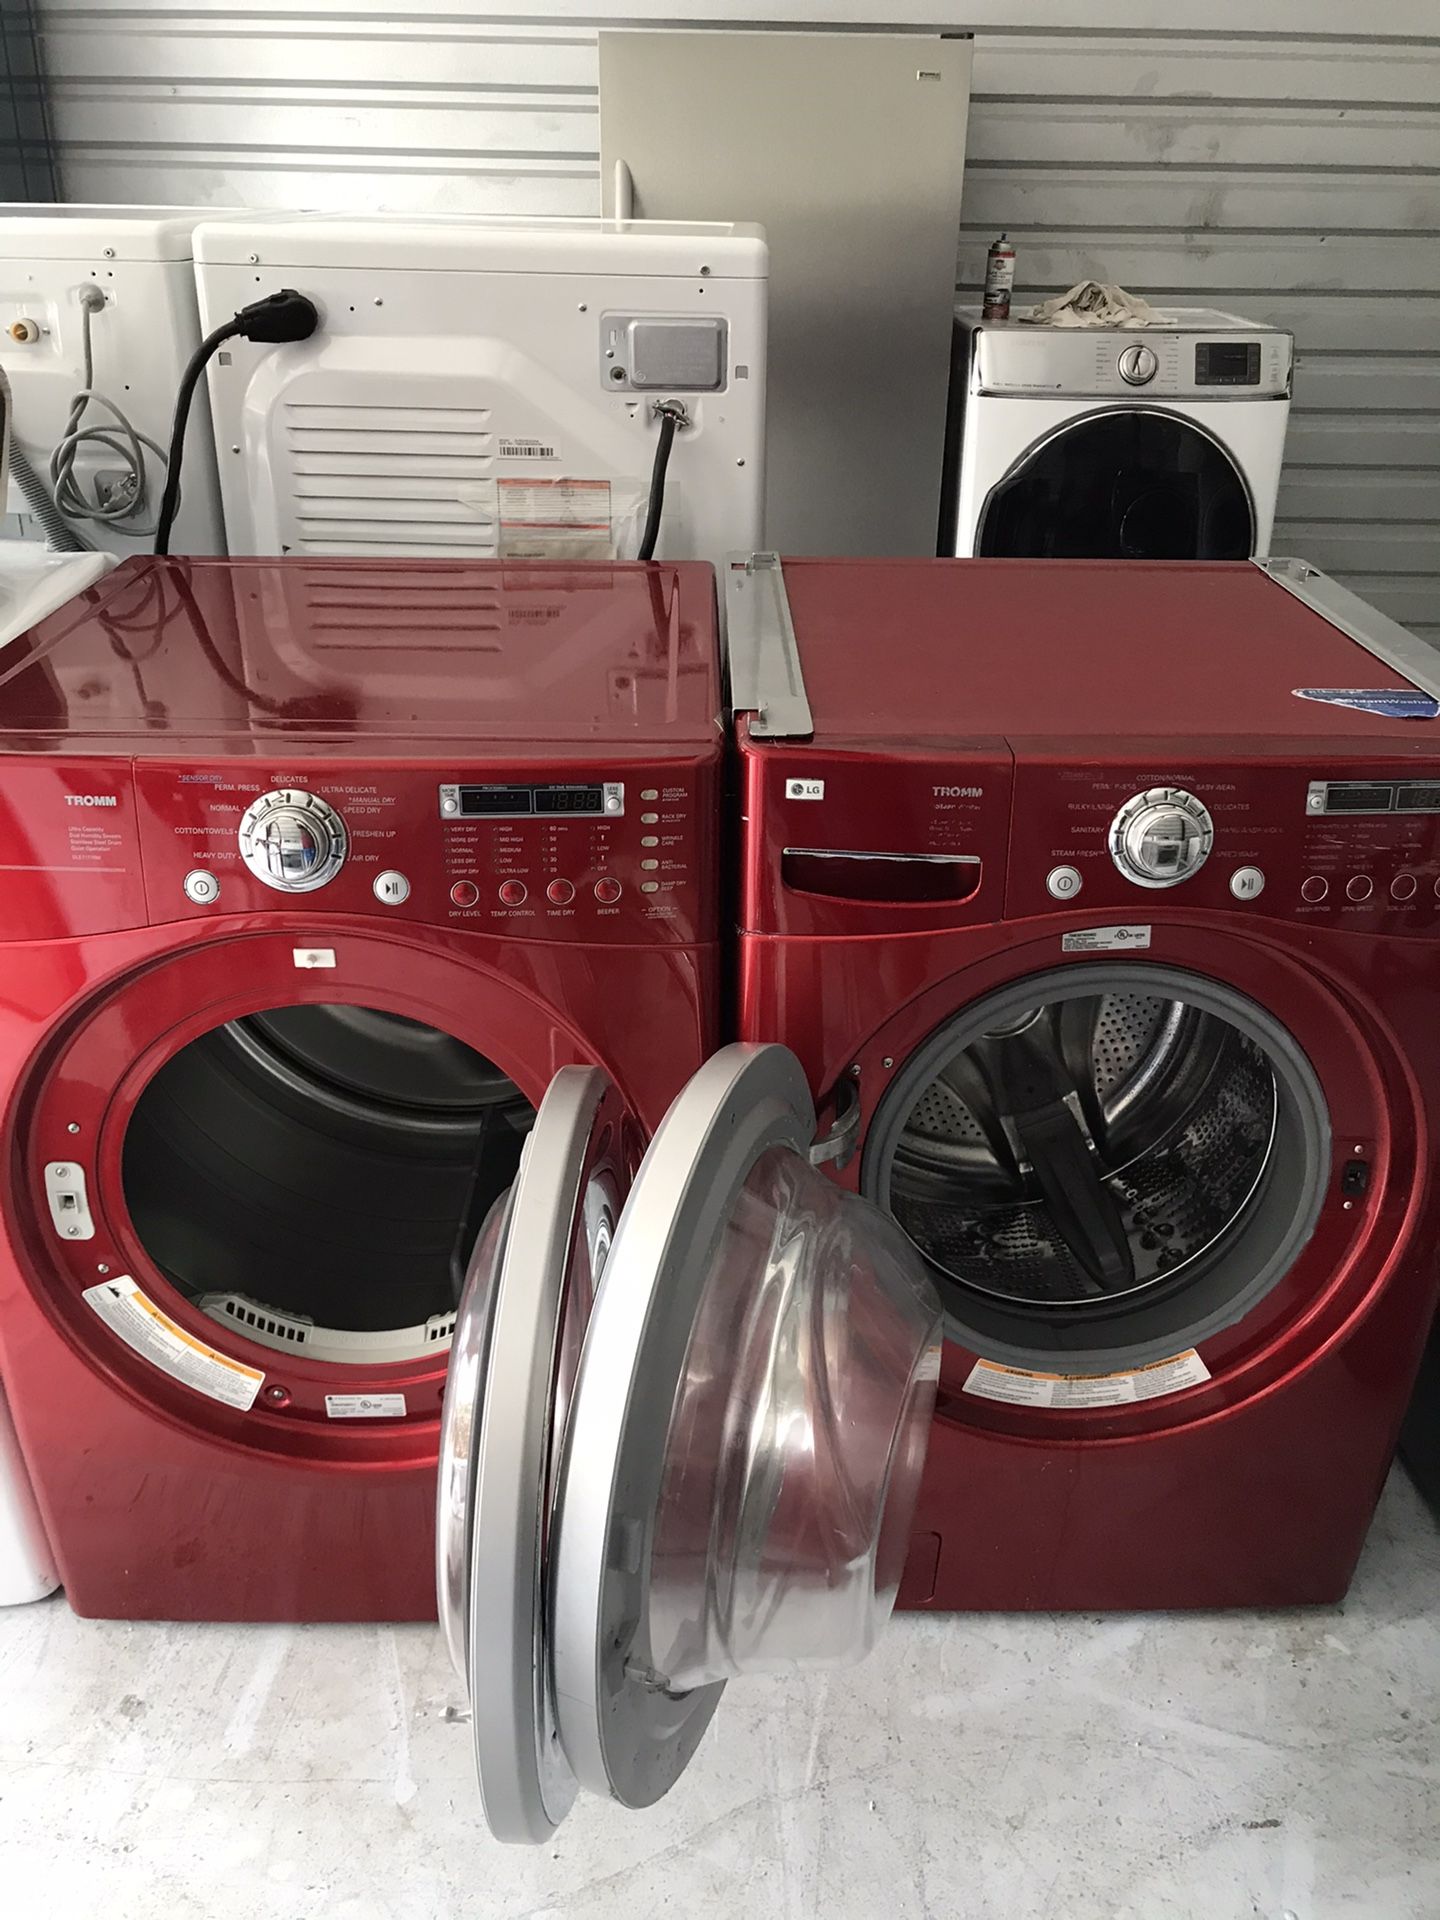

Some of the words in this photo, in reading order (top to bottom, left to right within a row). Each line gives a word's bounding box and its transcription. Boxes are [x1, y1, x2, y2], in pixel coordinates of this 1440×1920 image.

[238, 784, 260, 792] PRESS
[345, 786, 377, 794] DELICATE
[806, 786, 820, 794] LG
[932, 787, 983, 797] TROMM
[64, 795, 117, 806] TROMM
[210, 804, 240, 812] NORMAL
[343, 806, 365, 814] SPEED
[367, 806, 382, 814] DRY
[174, 827, 233, 835] COTTON/TOWELS
